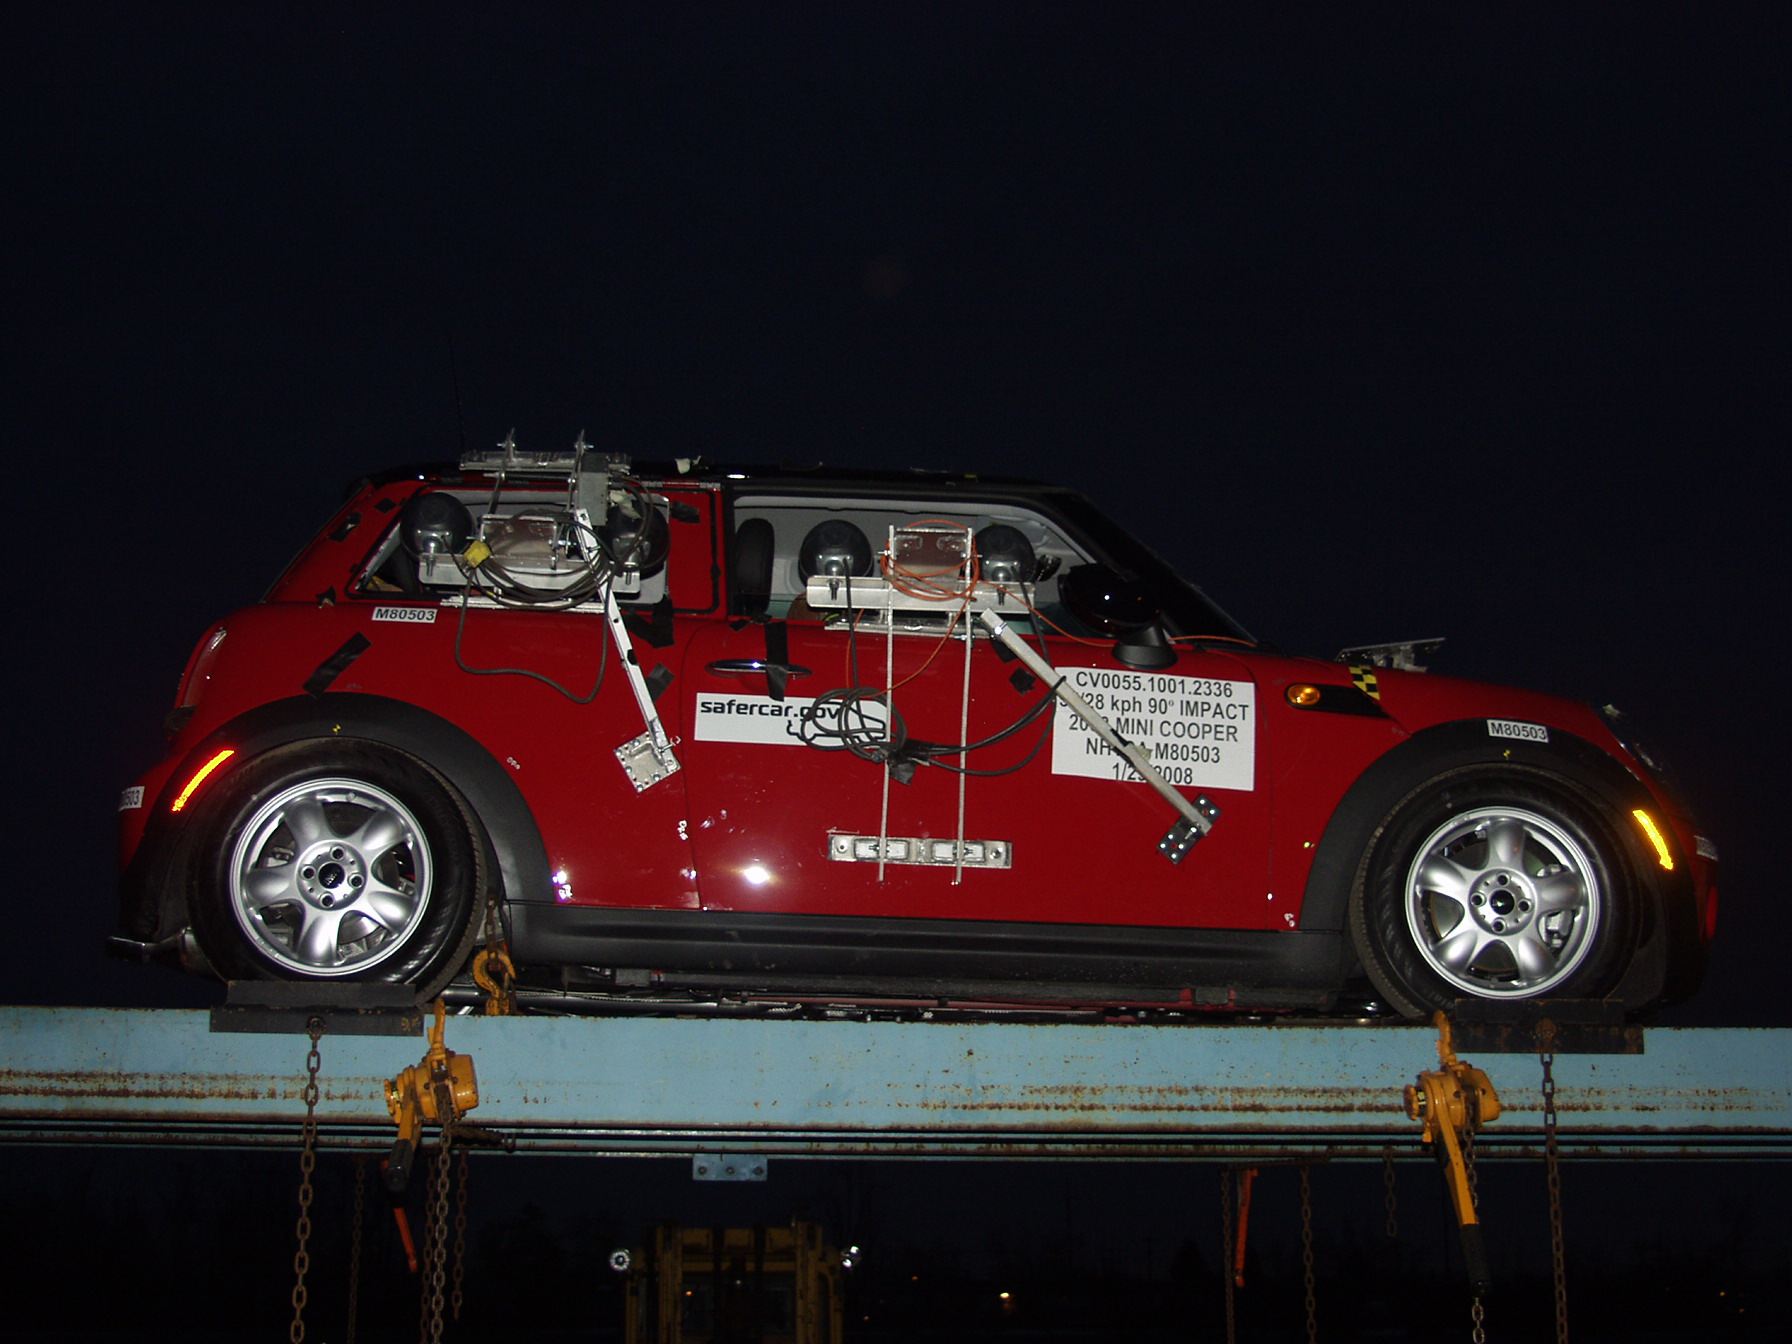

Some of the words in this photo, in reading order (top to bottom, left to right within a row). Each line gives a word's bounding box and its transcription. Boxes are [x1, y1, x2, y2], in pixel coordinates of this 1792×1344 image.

[375, 608, 435, 621] M80503
[1076, 671, 1233, 698] CV0055.1001.2336
[700, 699, 842, 722] safercar.gov
[1111, 695, 1142, 716] kph
[1180, 701, 1249, 721] IMPACT
[1116, 717, 1154, 736] MINI
[1160, 720, 1239, 742] COOPER
[1490, 722, 1547, 740] M80503
[1155, 743, 1221, 764] M80503
